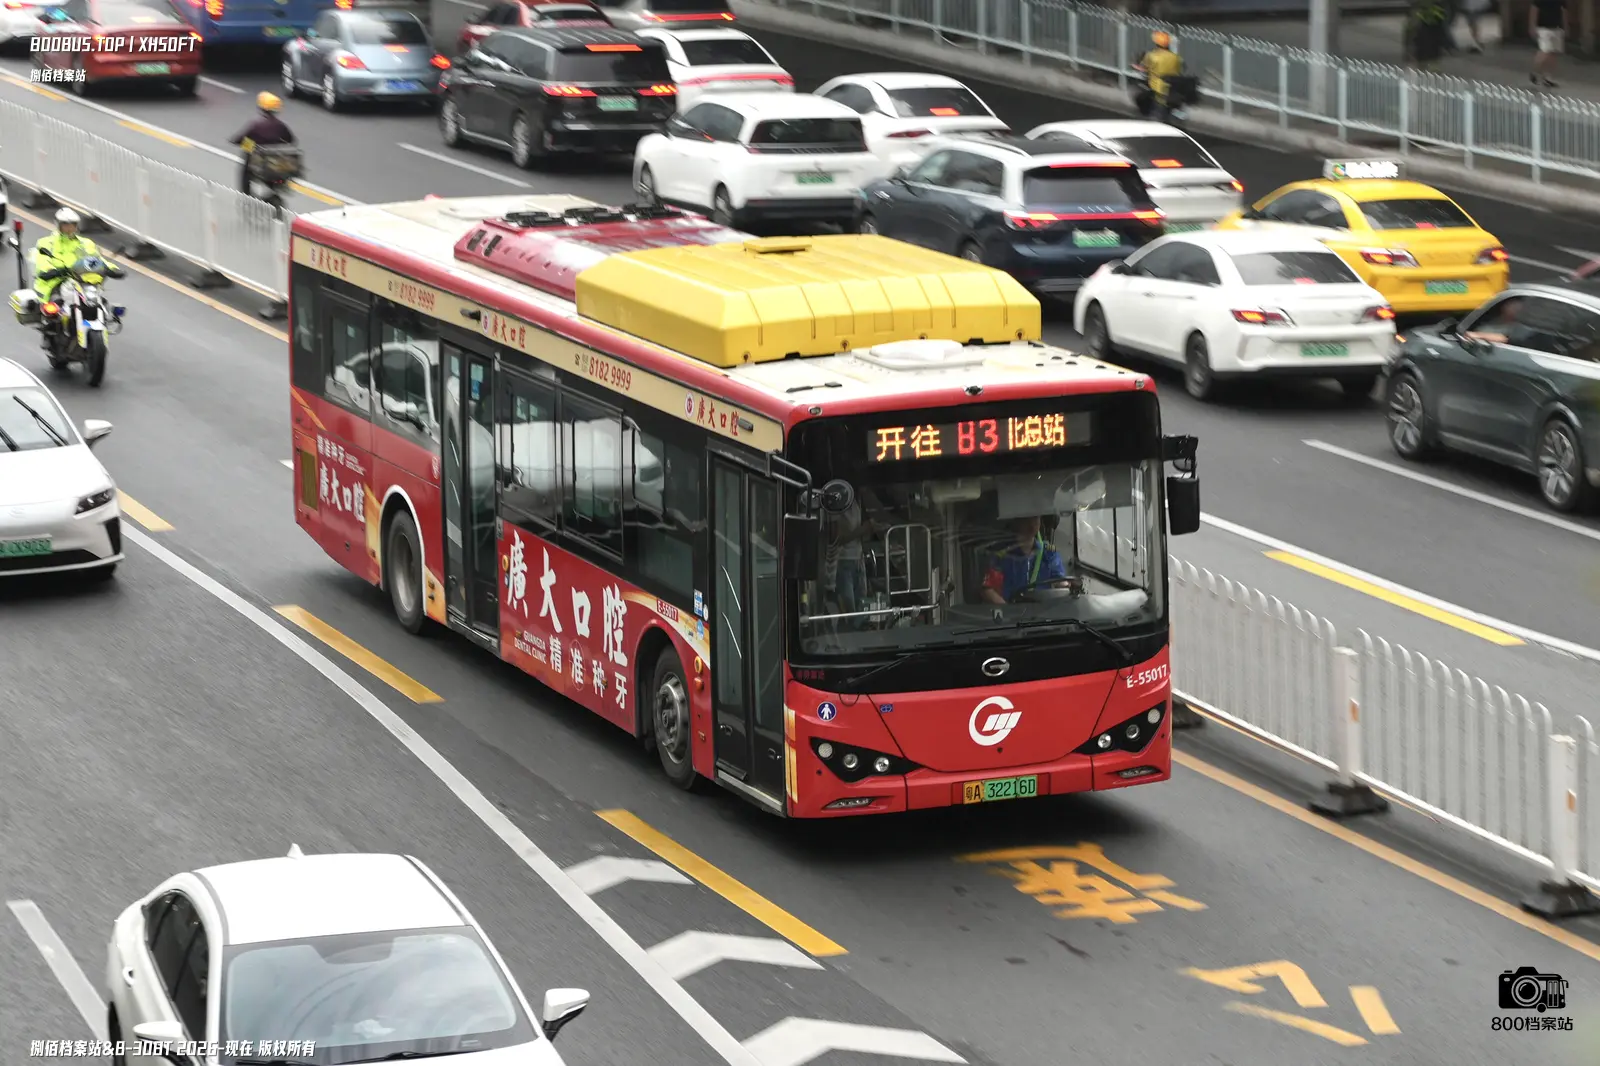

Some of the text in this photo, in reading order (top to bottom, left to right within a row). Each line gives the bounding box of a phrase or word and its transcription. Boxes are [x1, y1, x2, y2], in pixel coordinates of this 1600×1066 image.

[589, 356, 632, 391] 8182 9999
[876, 424, 942, 461] 开往
[657, 599, 678, 621] E-55017
[1126, 664, 1167, 689] E-55017
